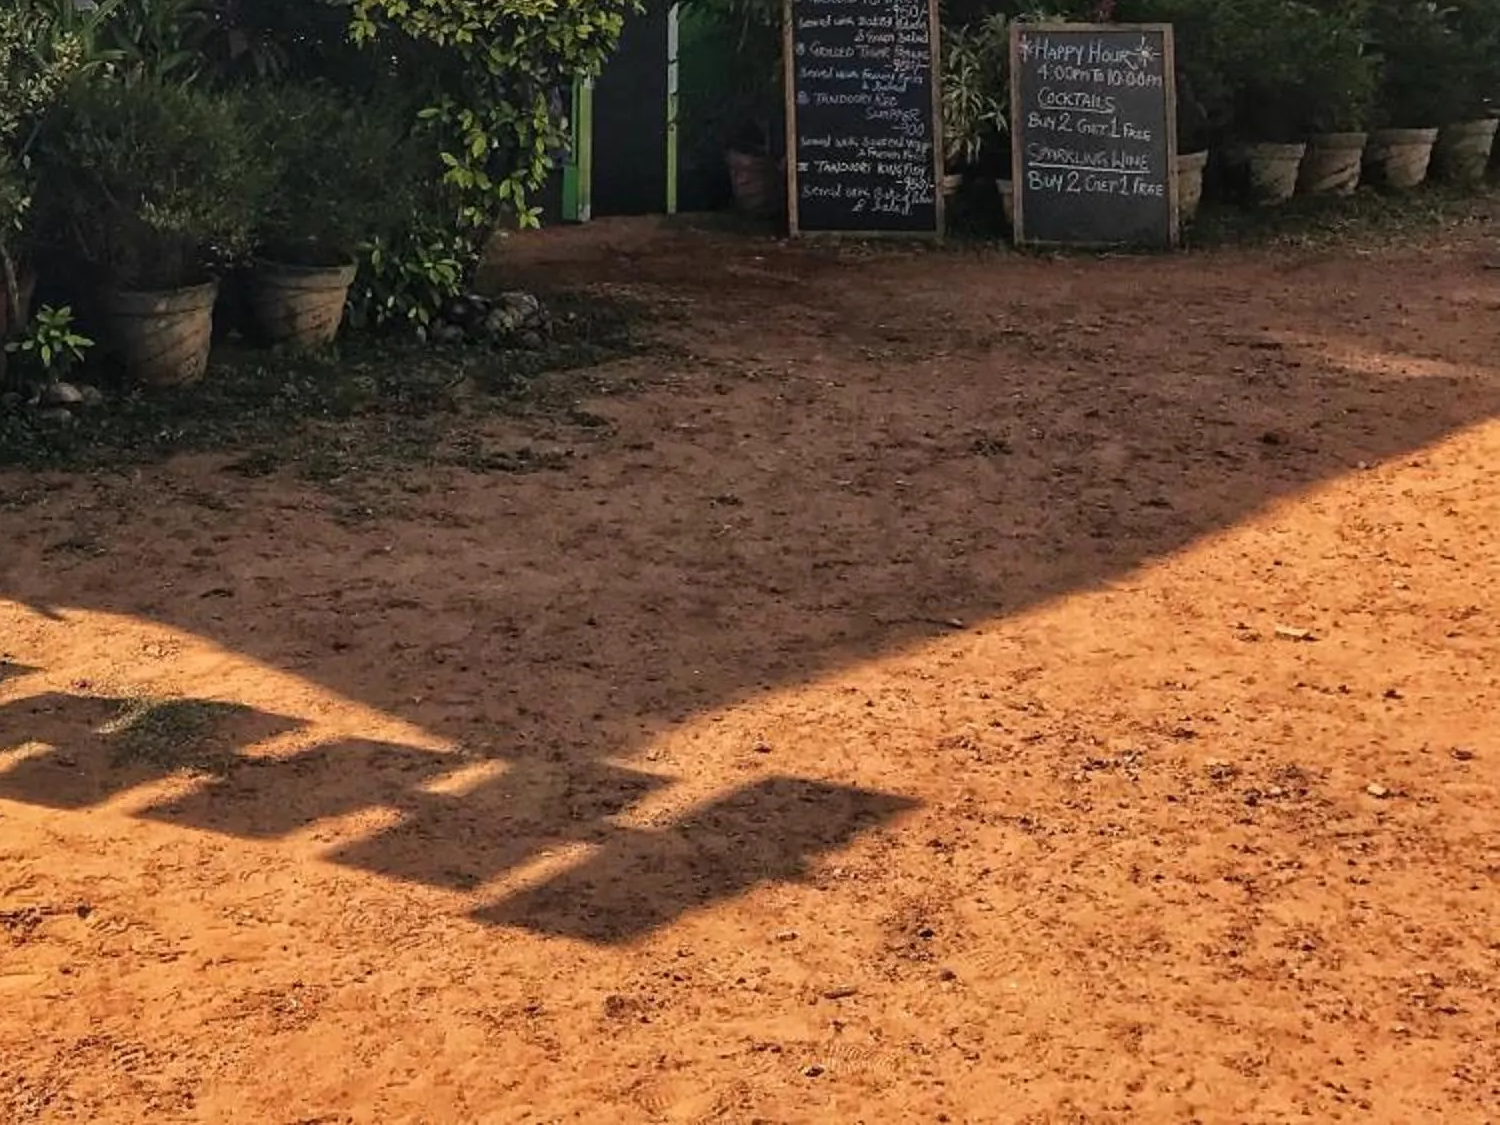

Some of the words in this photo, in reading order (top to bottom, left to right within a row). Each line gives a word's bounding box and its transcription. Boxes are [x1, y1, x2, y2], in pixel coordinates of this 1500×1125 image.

[1035, 38, 1085, 65] HAPPY
[1037, 86, 1116, 113] COCKTAILS
[1058, 113, 1073, 132] 2
[1110, 116, 1121, 138] 1
[1066, 171, 1081, 192] 2
[1119, 175, 1130, 196] 1
